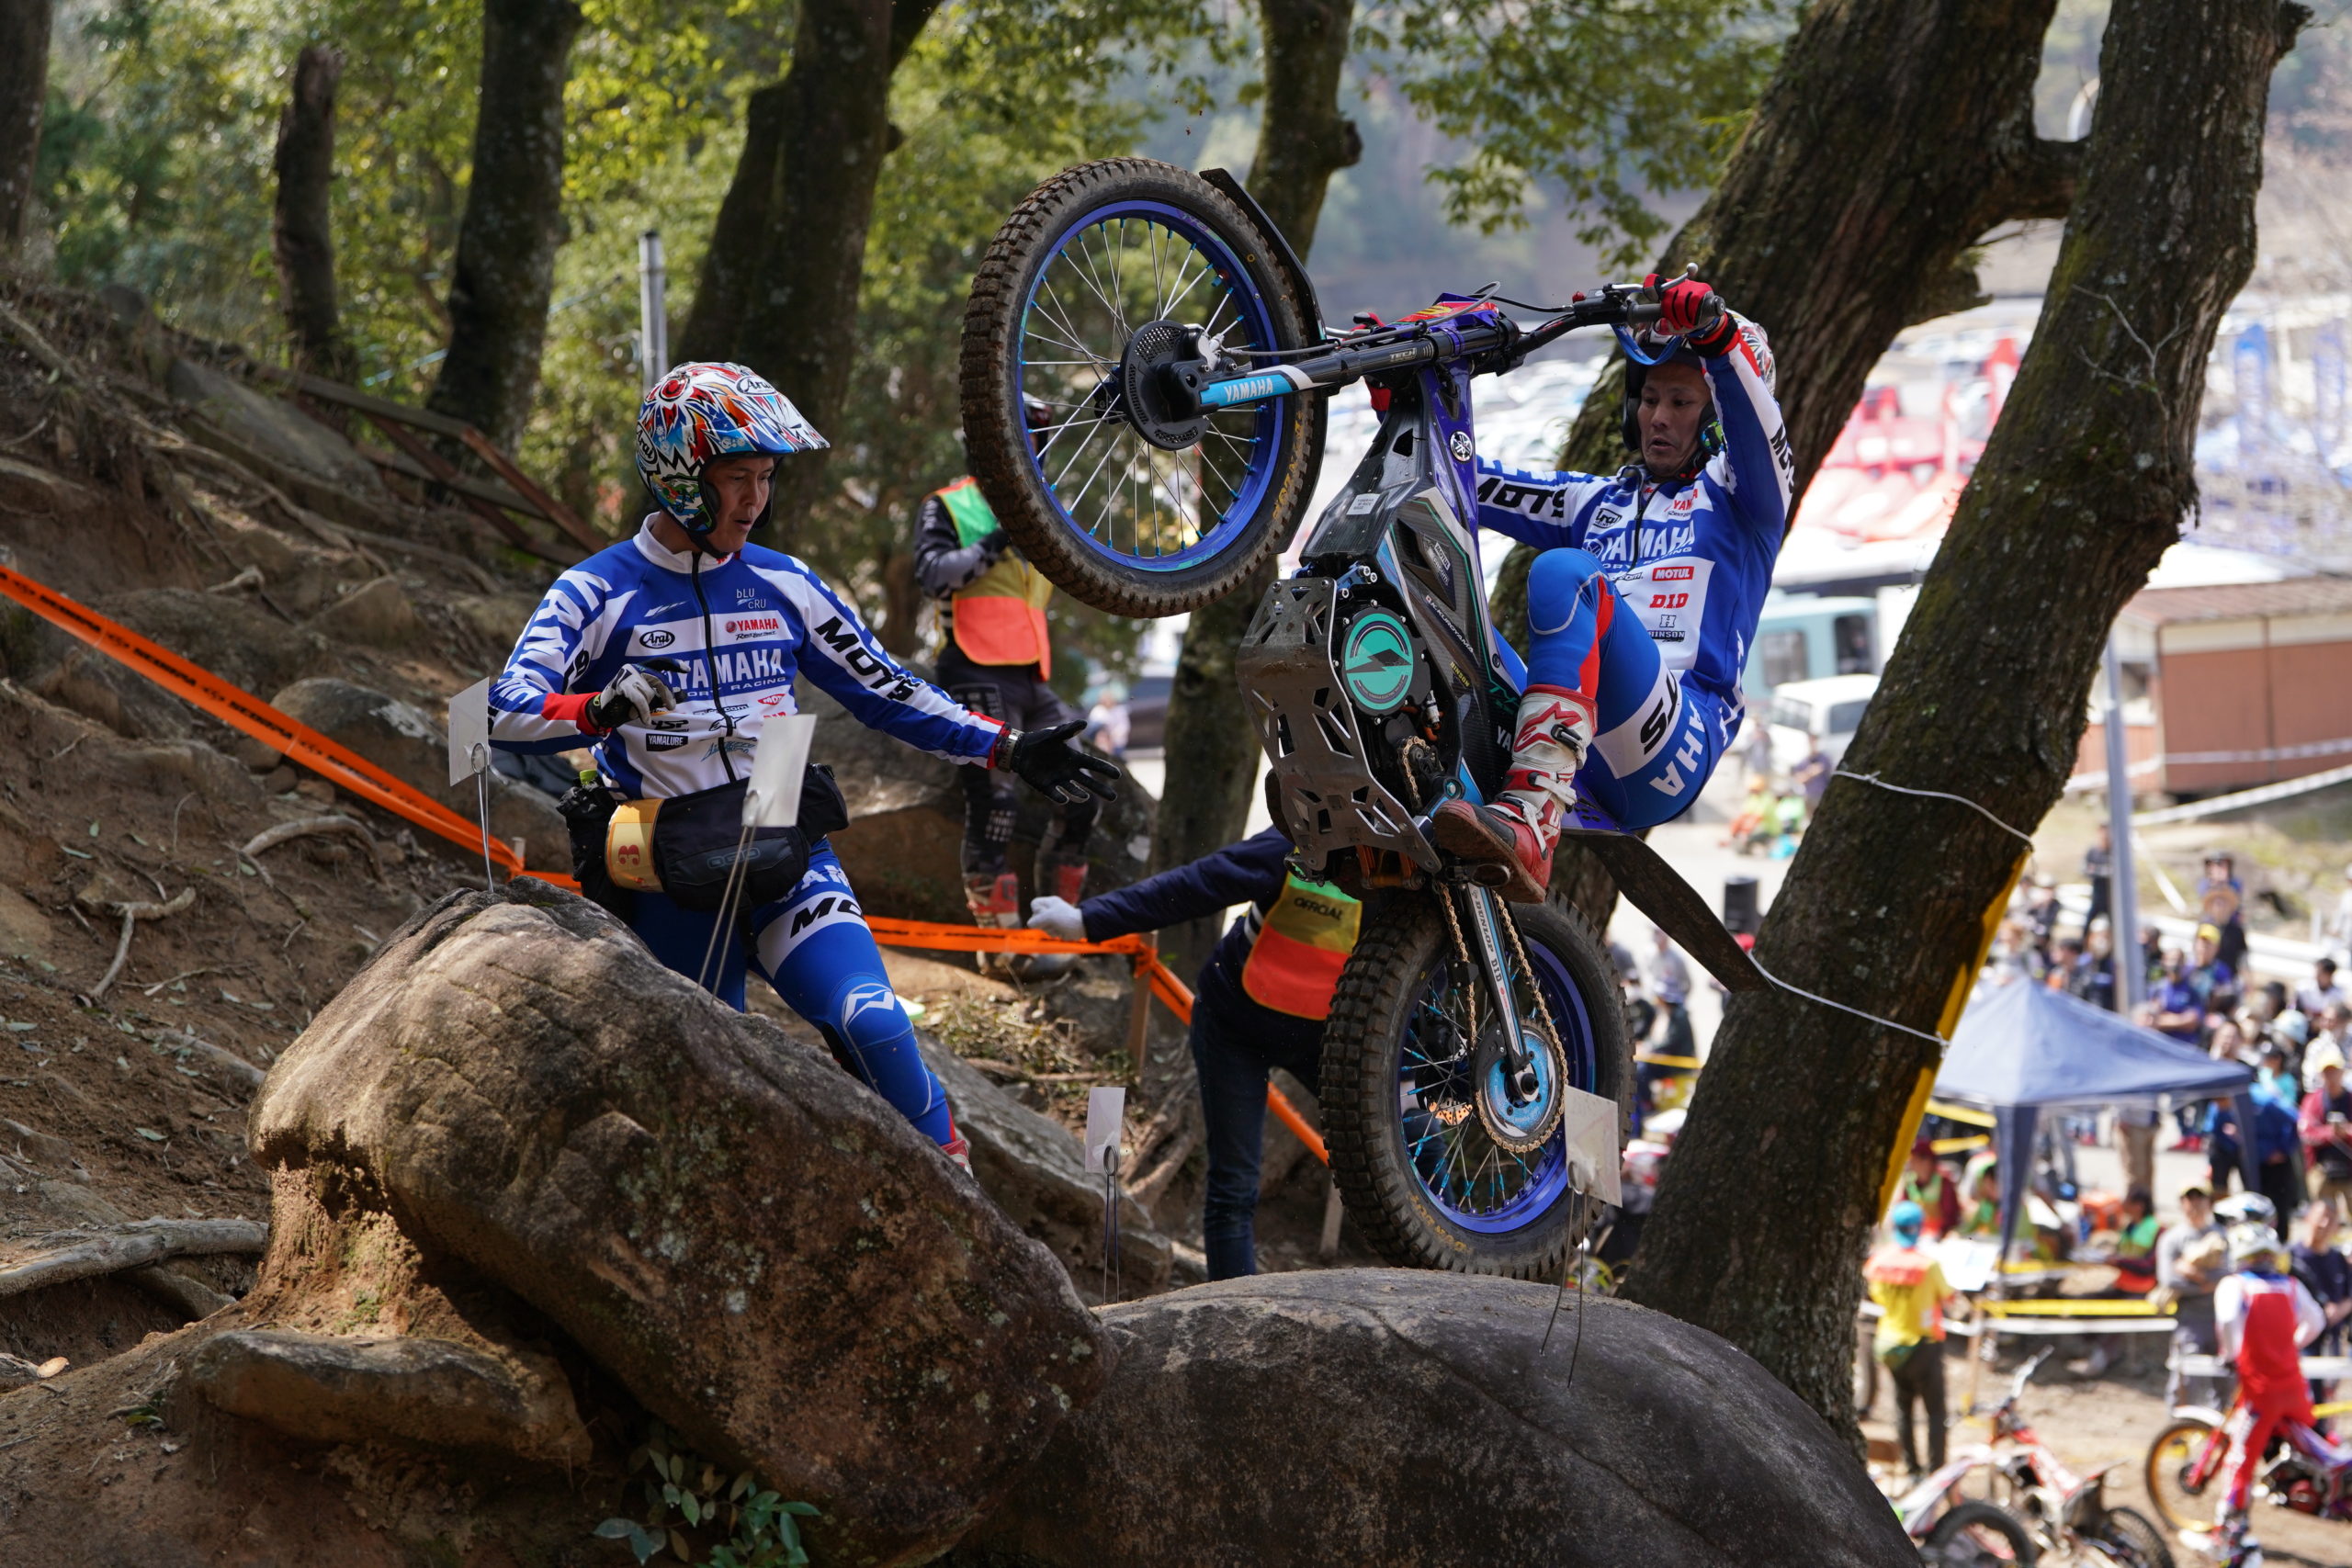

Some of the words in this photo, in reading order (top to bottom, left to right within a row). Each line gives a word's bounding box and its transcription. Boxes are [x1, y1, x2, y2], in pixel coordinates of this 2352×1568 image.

[1223, 377, 1273, 402] YAMAHA
[1654, 569, 1690, 580] MOTUL
[737, 618, 779, 631] YAMAHA
[644, 630, 670, 644] Arai
[678, 648, 786, 690] YAMAHA
[730, 677, 786, 691] RACING
[649, 736, 684, 746] YAMALUBE
[1475, 899, 1495, 953] DUNLOP
